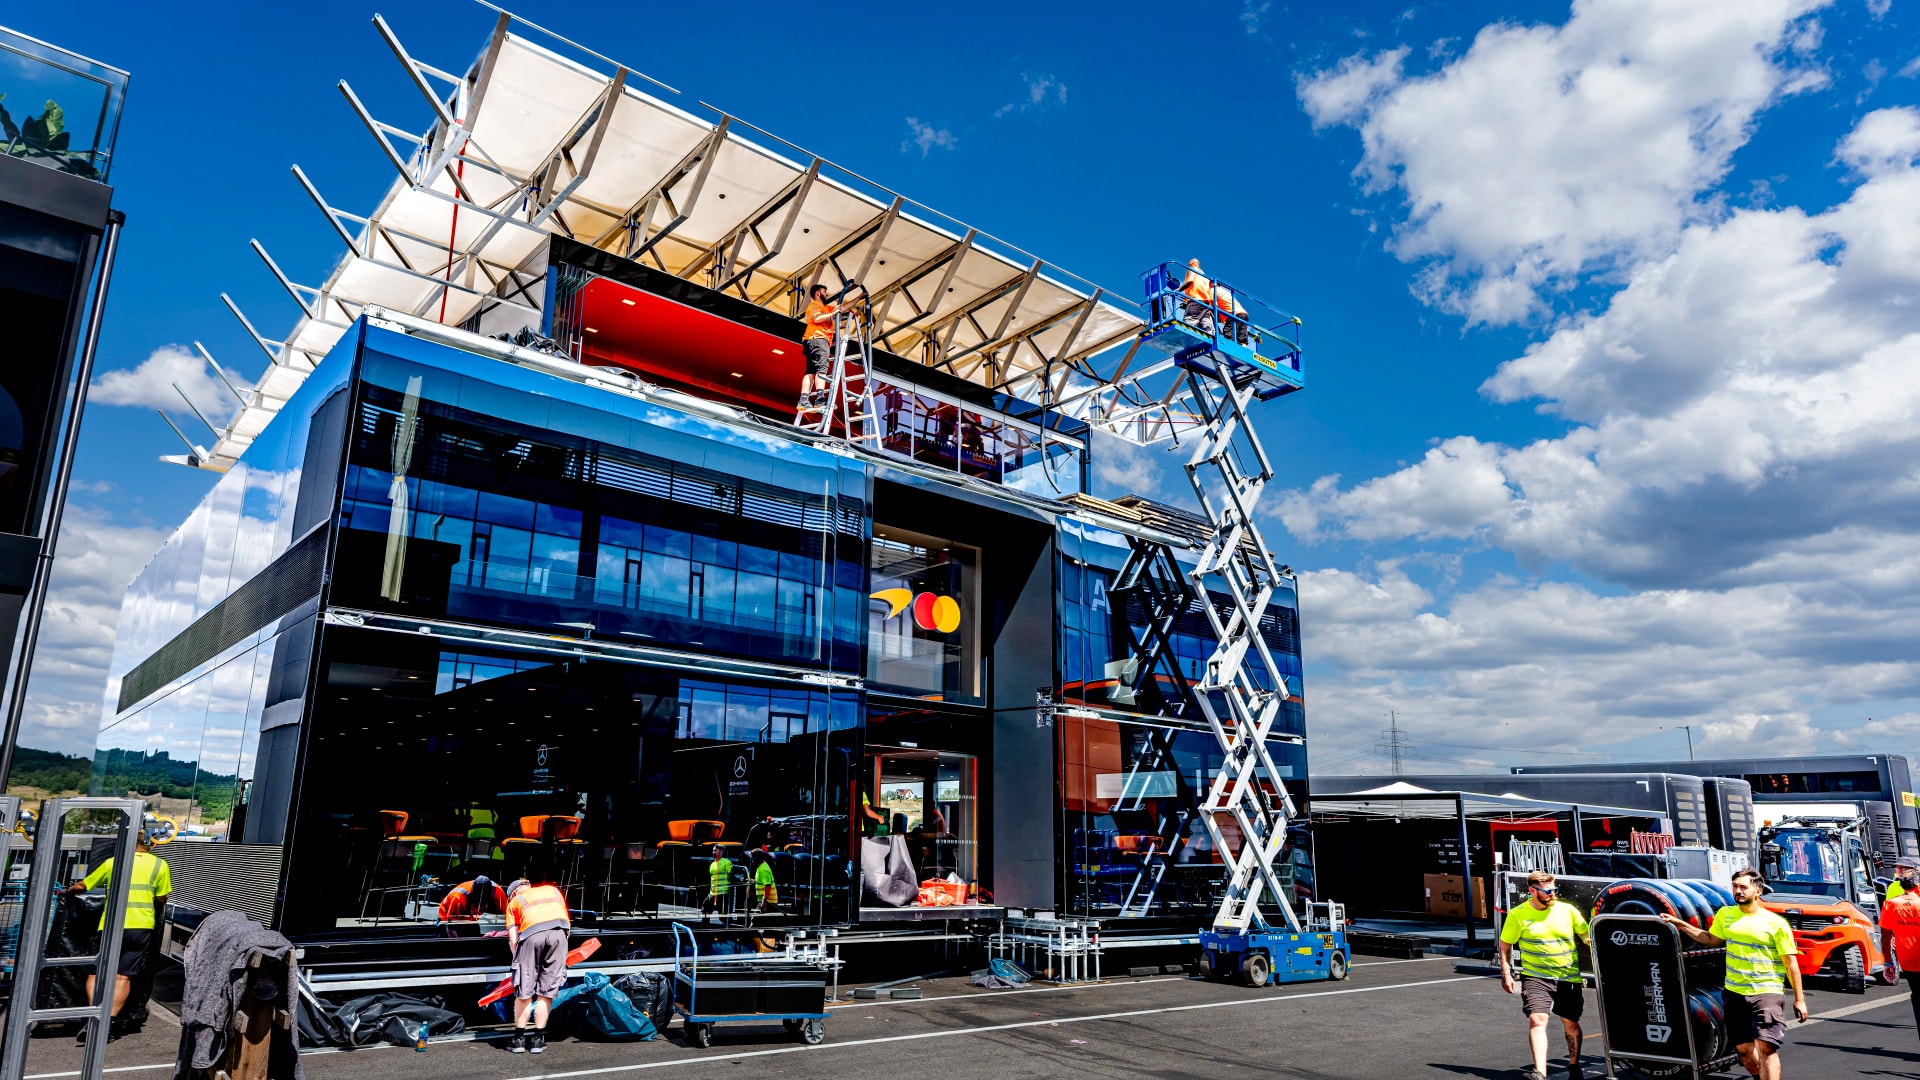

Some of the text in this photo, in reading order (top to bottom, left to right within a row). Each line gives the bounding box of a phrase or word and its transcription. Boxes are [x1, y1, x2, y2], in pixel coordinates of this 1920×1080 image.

[1628, 933, 1659, 942] TGR
[1649, 962, 1667, 1023] BEARMAN
[1645, 1024, 1672, 1043] 87
